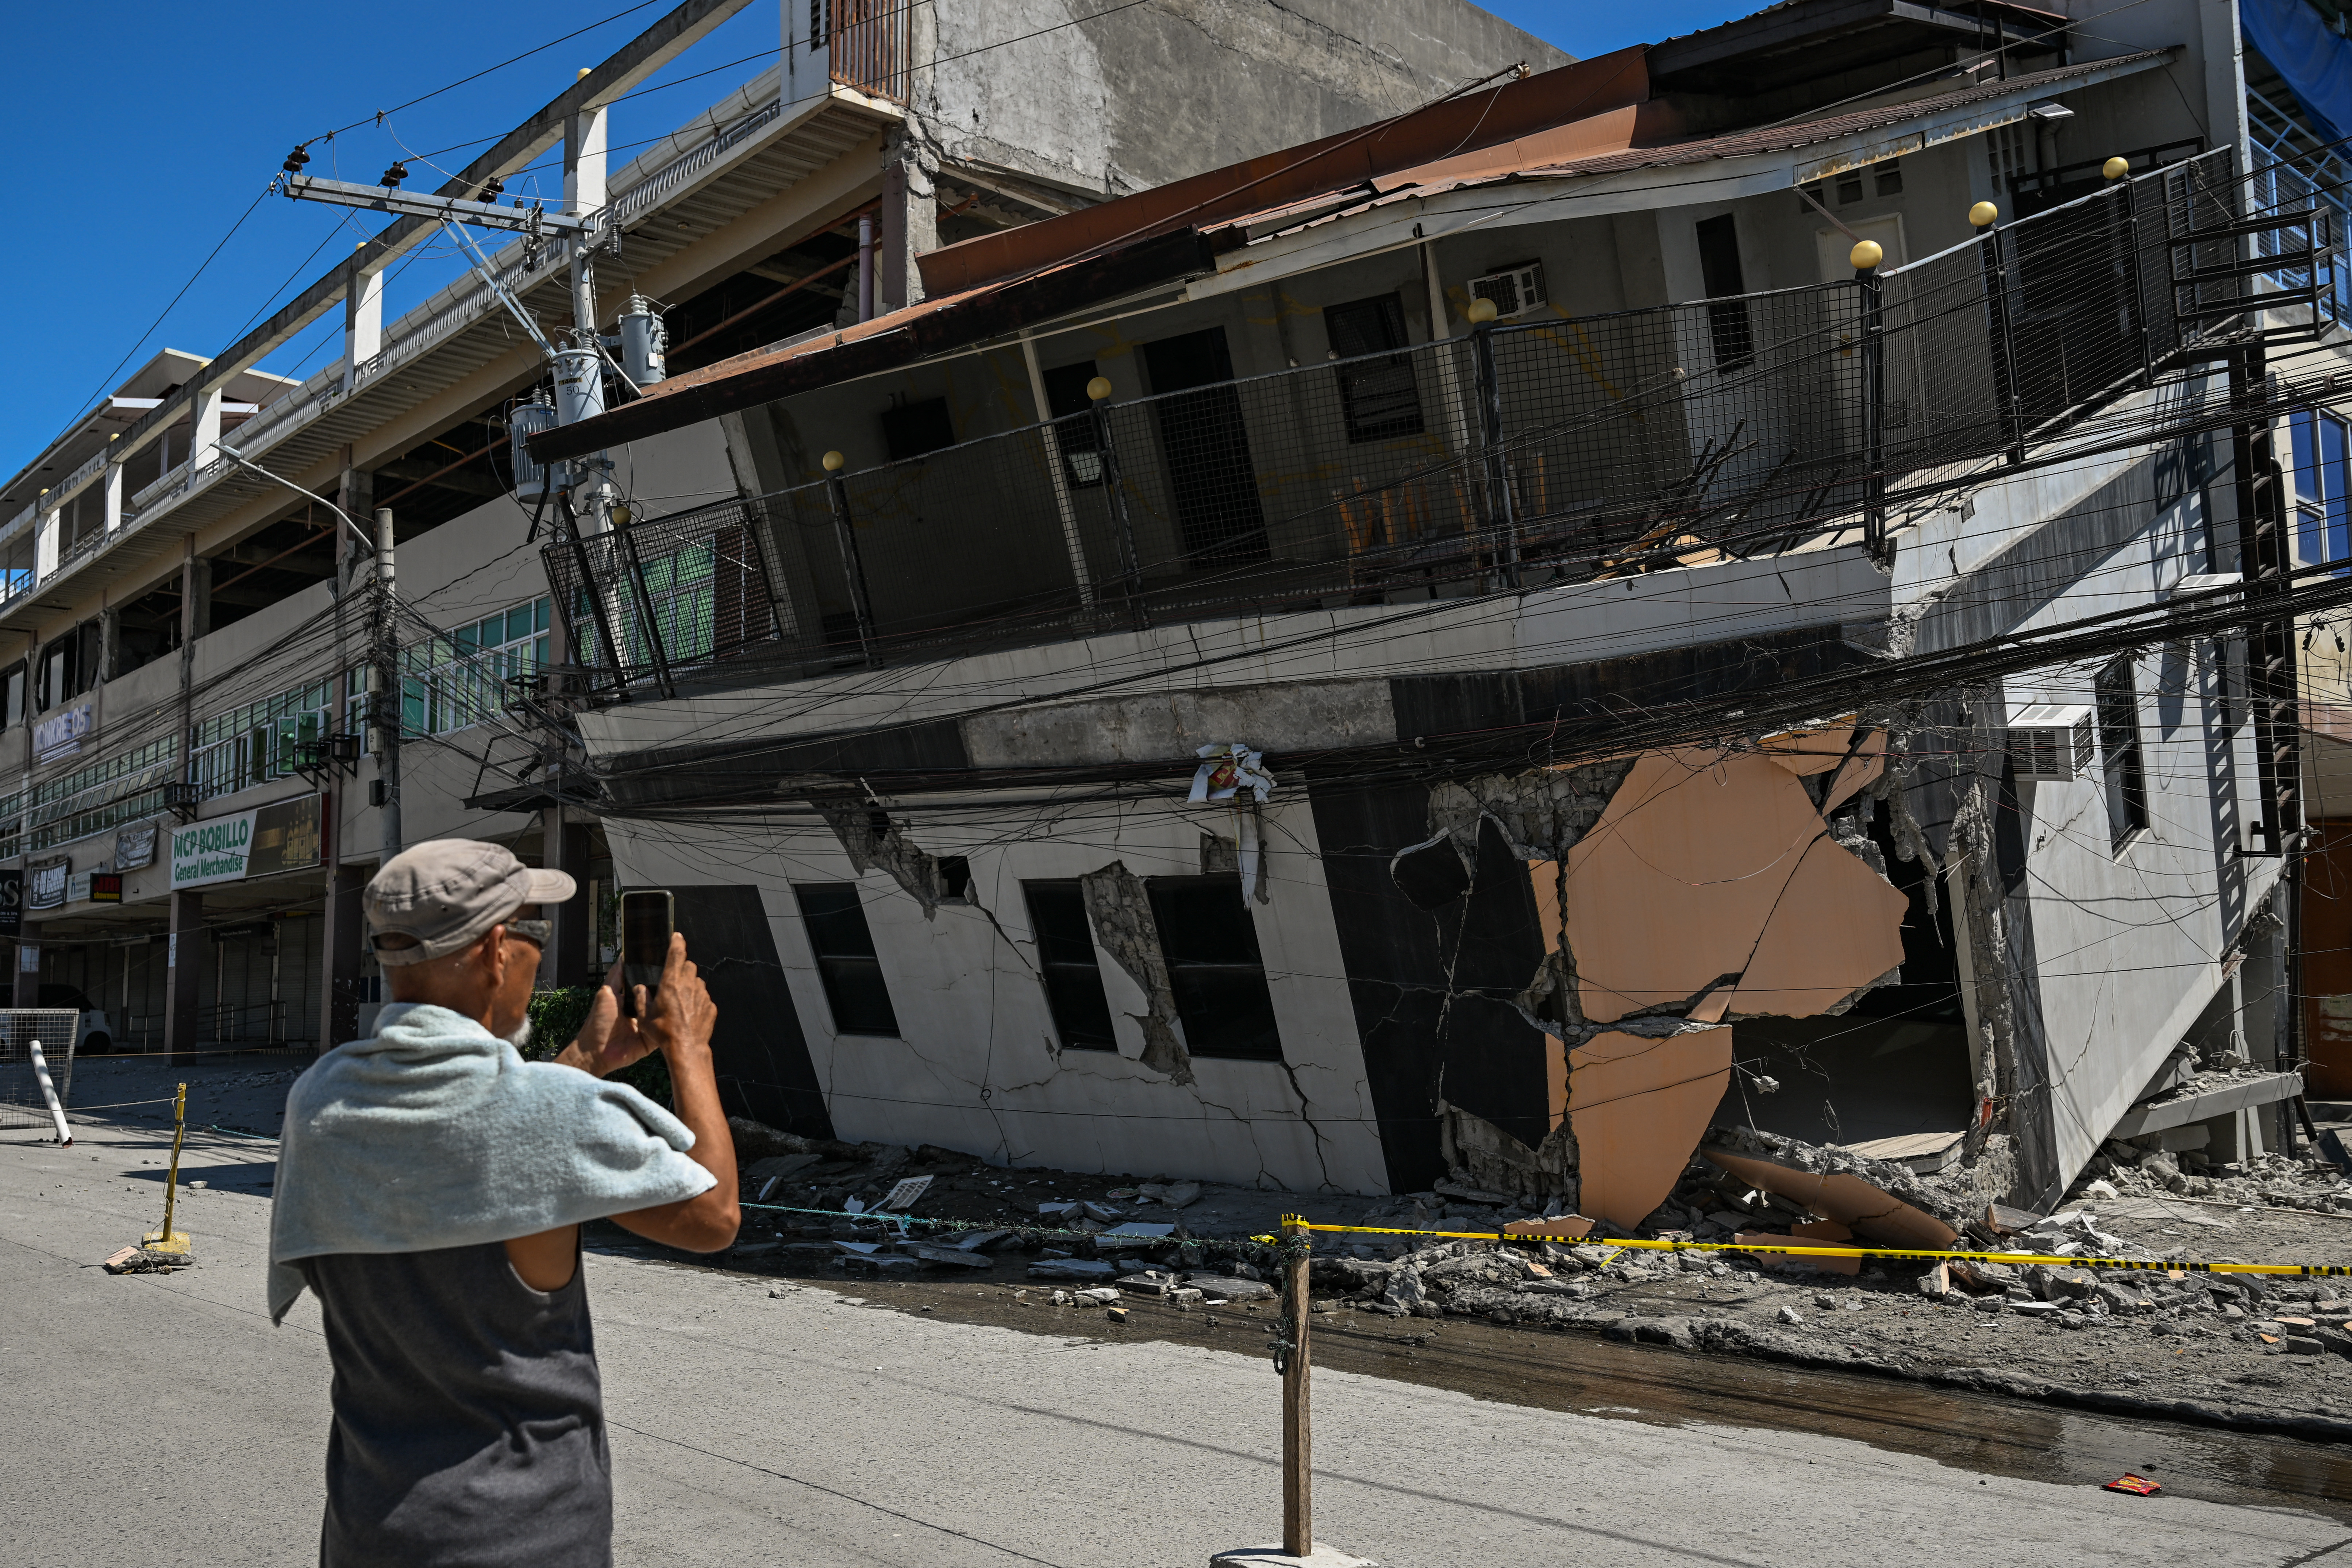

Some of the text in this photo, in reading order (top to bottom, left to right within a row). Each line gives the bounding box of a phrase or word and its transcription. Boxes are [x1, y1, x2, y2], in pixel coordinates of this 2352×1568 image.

[558, 377, 581, 386] F14461
[566, 385, 580, 395] 50
[174, 831, 197, 859] MCP
[199, 819, 248, 854] BOBILLO
[175, 850, 243, 882] General Merchandise
